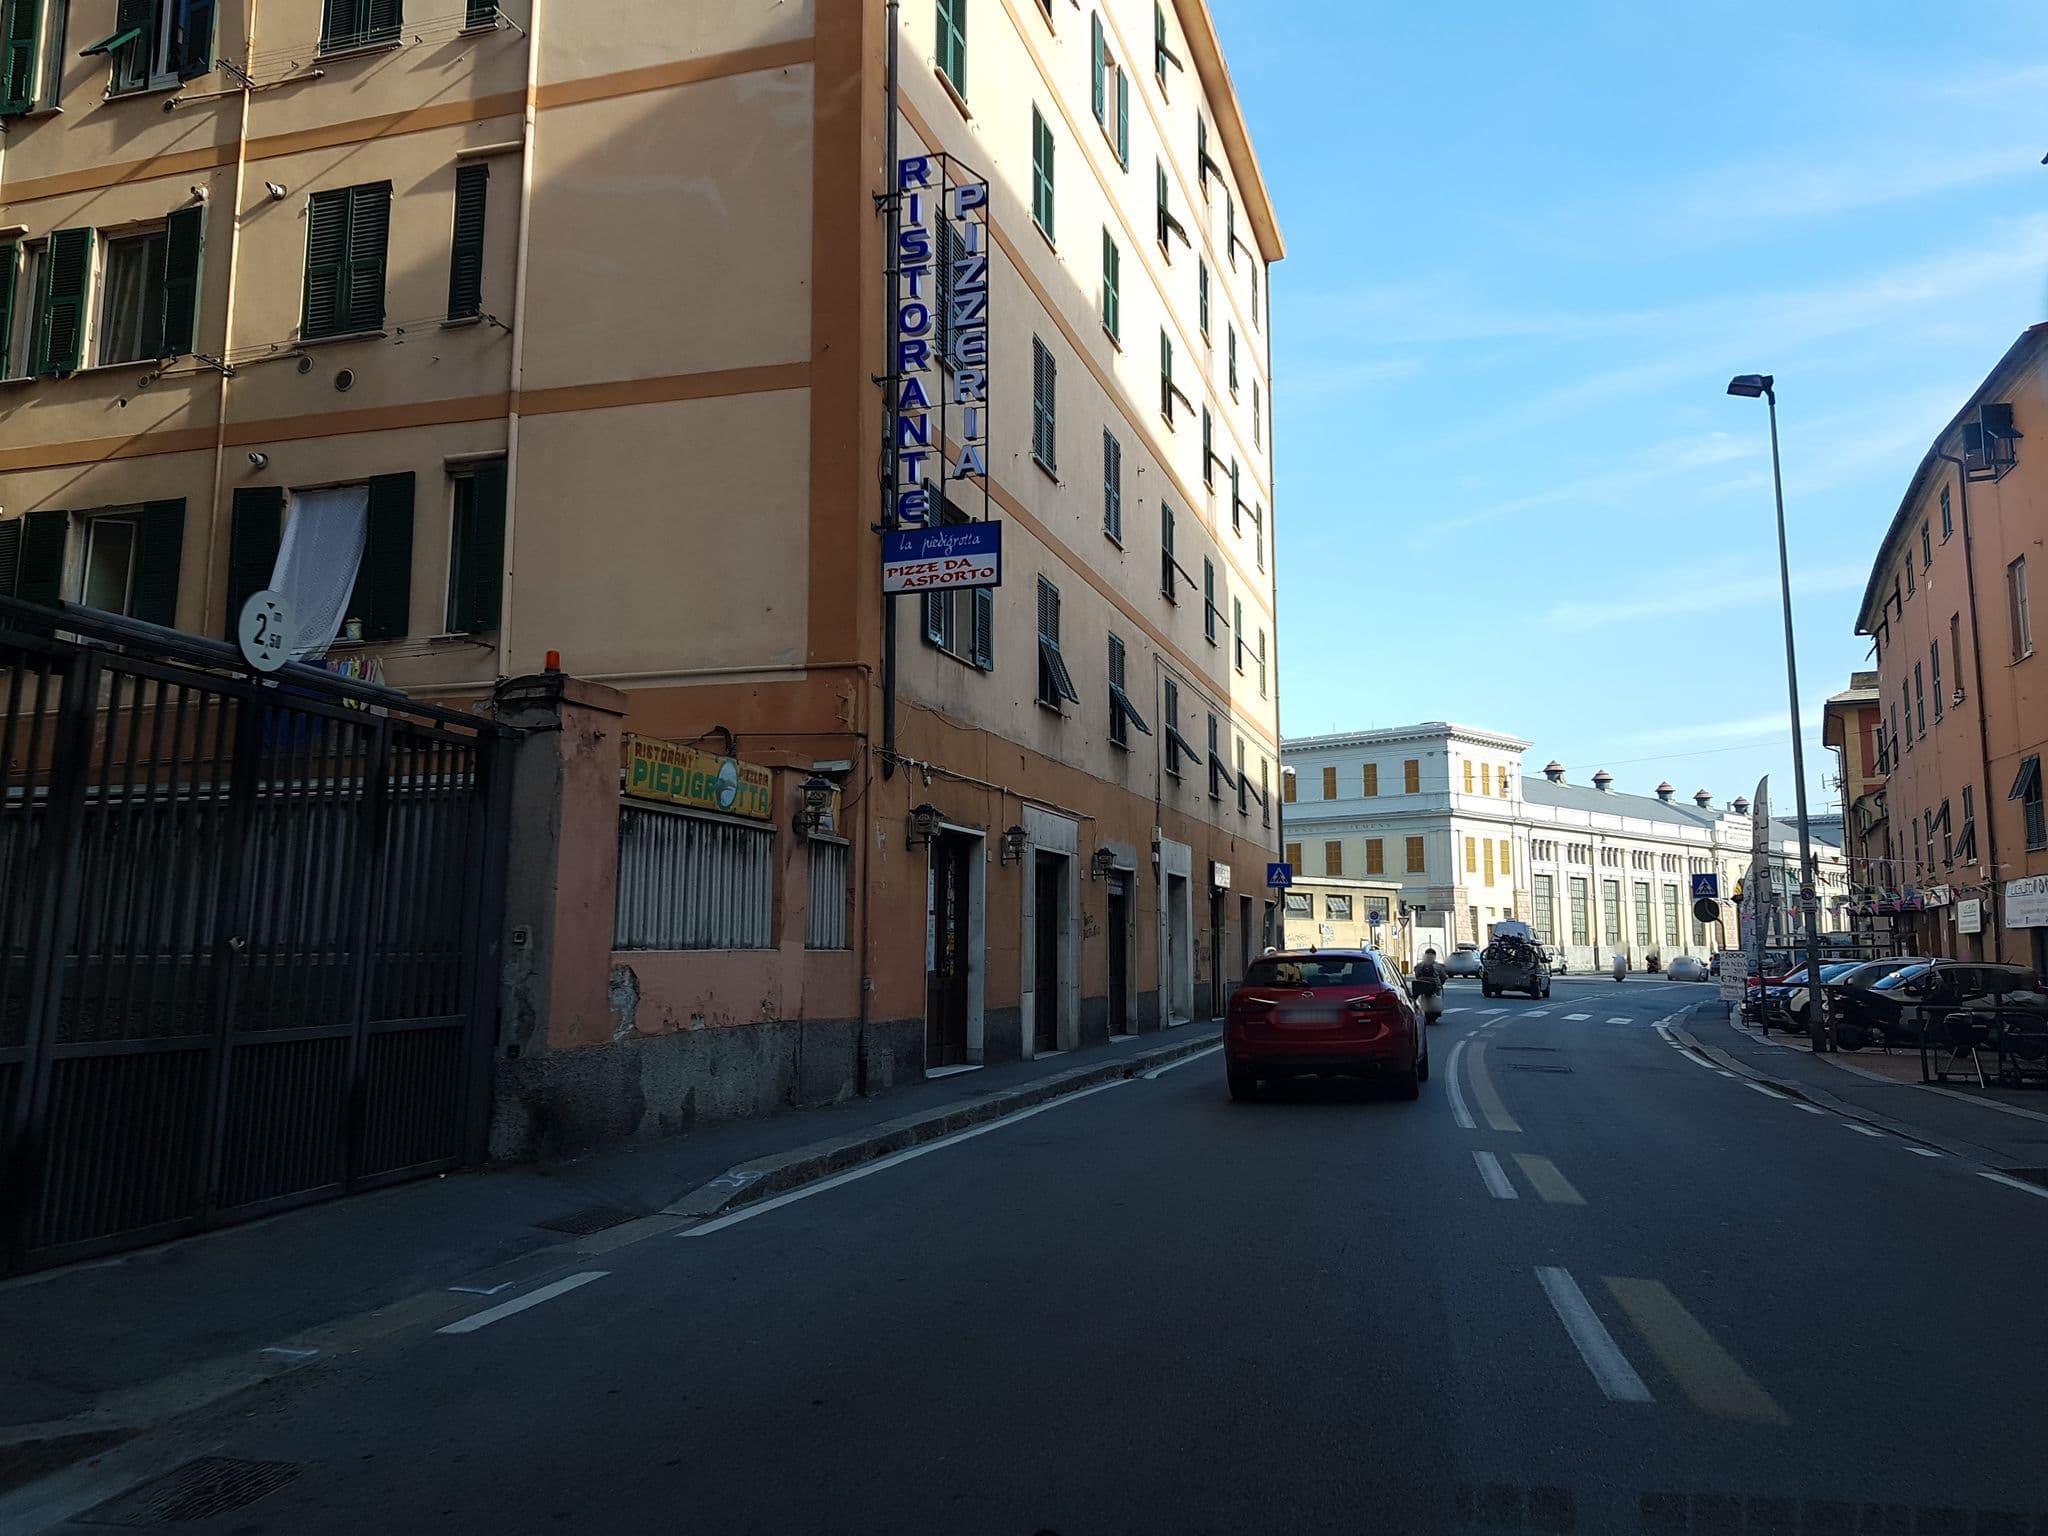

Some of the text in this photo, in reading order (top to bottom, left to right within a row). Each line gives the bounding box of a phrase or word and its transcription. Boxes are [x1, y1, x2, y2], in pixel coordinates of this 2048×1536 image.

[899, 156, 931, 524] RISTORANTE
[953, 183, 986, 480] PIZZERIA
[900, 531, 981, 558] la piedigrotta
[887, 558, 972, 579] PIZZE DA
[901, 567, 994, 588] ASPORTO
